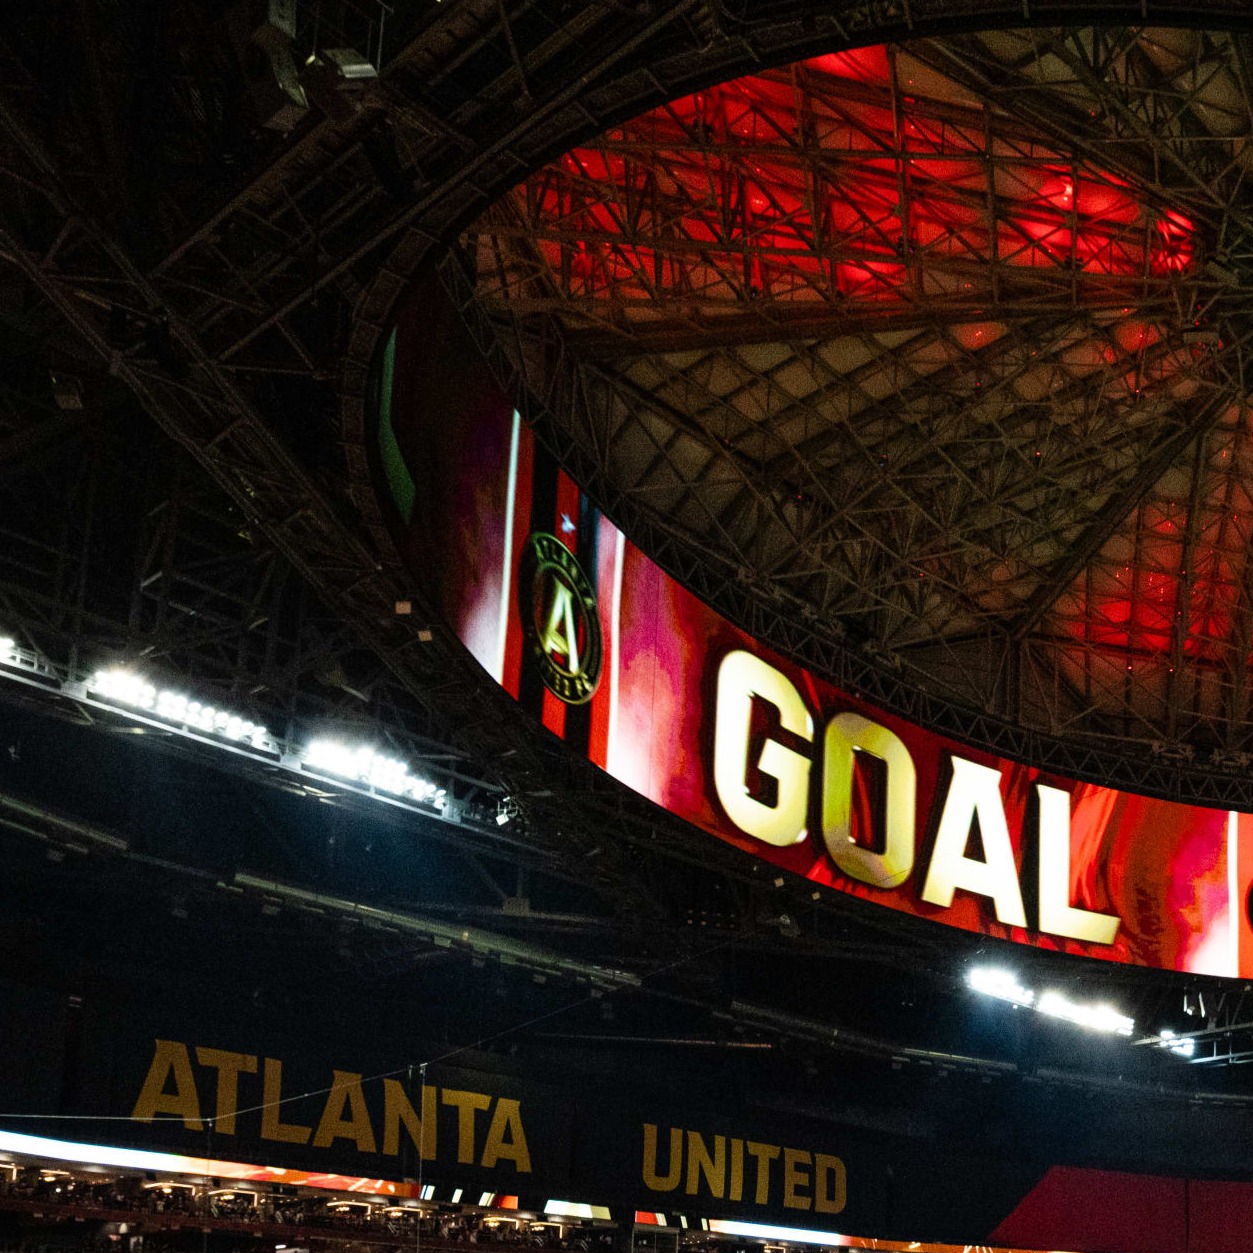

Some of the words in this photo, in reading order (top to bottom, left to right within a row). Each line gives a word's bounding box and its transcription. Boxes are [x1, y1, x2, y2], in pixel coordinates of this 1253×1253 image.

[714, 648, 1121, 945] GOAL
[131, 1038, 532, 1173] ATLANTA
[641, 1122, 848, 1215] UNITED
